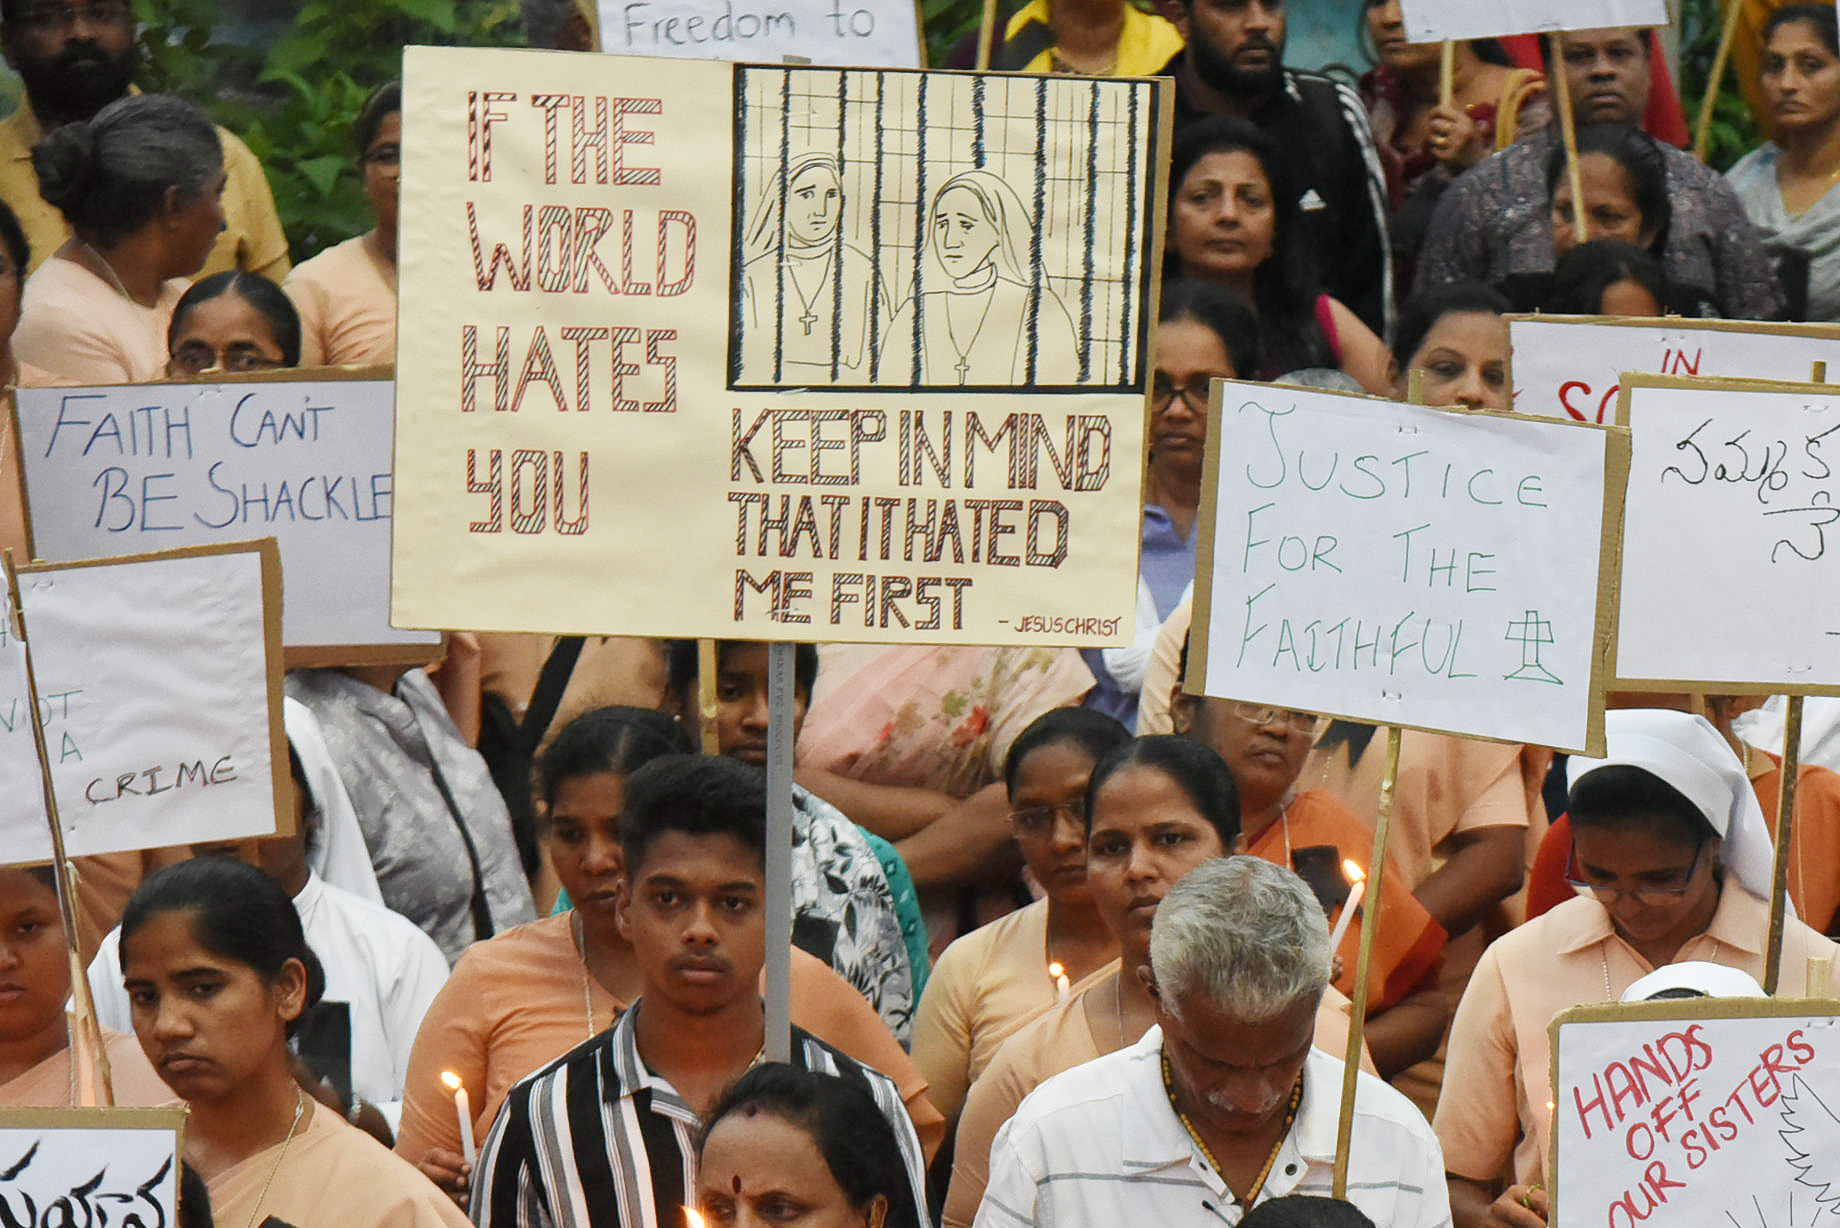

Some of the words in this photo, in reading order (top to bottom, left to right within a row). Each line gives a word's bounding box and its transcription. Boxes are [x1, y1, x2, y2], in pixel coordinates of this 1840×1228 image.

[623, 0, 795, 46] Freedom
[826, 0, 876, 38] to
[467, 91, 517, 184] IF
[531, 93, 662, 186] THE
[465, 202, 697, 297] WORLD
[462, 325, 678, 414] HATES
[1661, 348, 1704, 376] IN
[43, 395, 195, 459] FAITH
[730, 408, 887, 486] KEEP
[898, 410, 953, 489] IN
[964, 411, 1112, 492] MIND
[1239, 402, 1550, 509] JUSTICE
[91, 466, 184, 532] BE
[467, 449, 591, 536] YOU
[727, 492, 851, 560] THAT
[858, 496, 900, 562] IT
[903, 498, 1071, 569] HATED
[1242, 503, 1342, 576] FOR
[1392, 522, 1499, 593] THE
[733, 570, 813, 623] ME
[829, 572, 973, 630] FIRST
[1236, 584, 1479, 680] FAITHFUL
[60, 730, 84, 765] A
[84, 755, 239, 805] CRIME
[1573, 1023, 1714, 1140] HANDS
[1625, 1078, 1703, 1161] OFF
[1680, 1029, 1817, 1170] SISTERS
